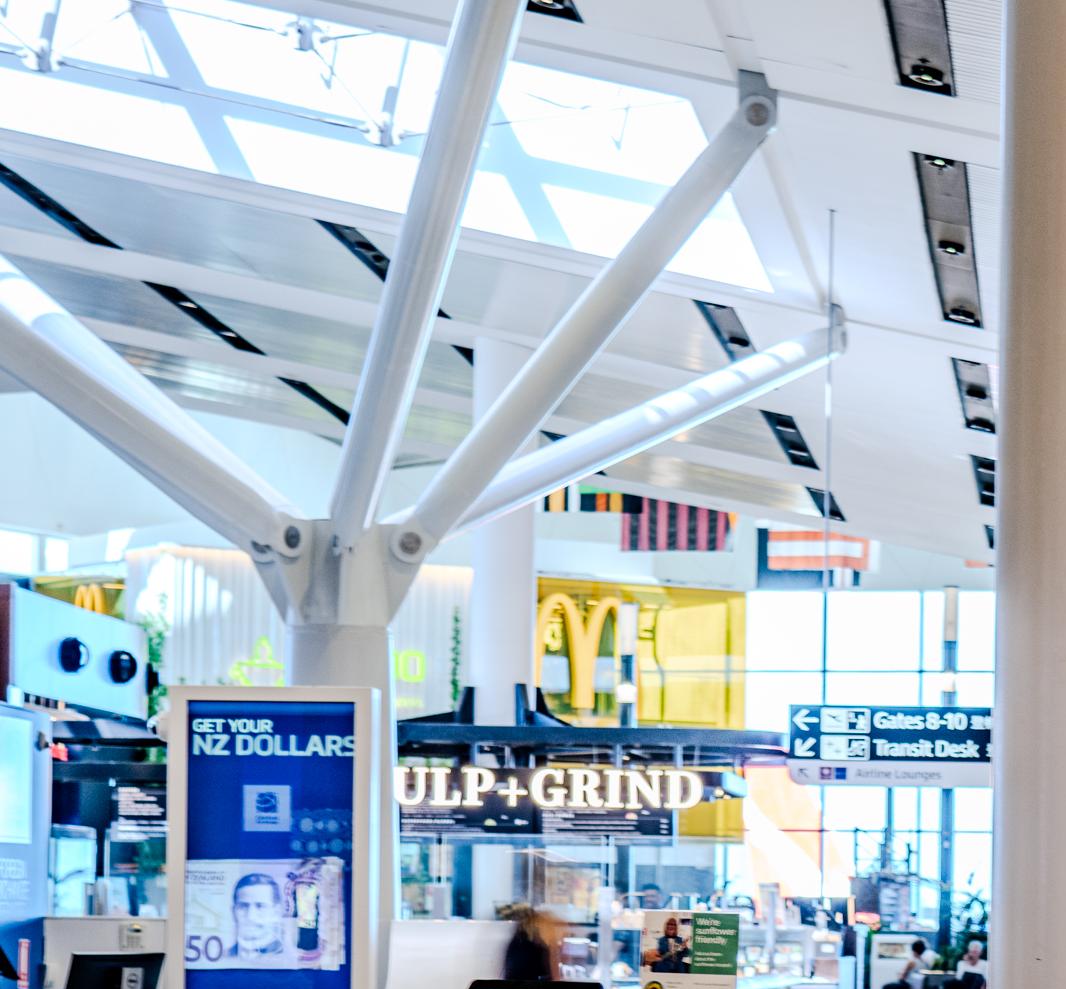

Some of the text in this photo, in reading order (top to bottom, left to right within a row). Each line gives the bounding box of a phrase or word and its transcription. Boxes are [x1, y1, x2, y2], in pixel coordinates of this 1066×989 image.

[192, 718, 274, 734] GET YOUR
[873, 711, 925, 730] Gates
[192, 734, 355, 757] NZ DOLLARS
[872, 739, 980, 759] Transit Desk
[855, 768, 889, 779] Airline
[894, 768, 941, 781] Lounges
